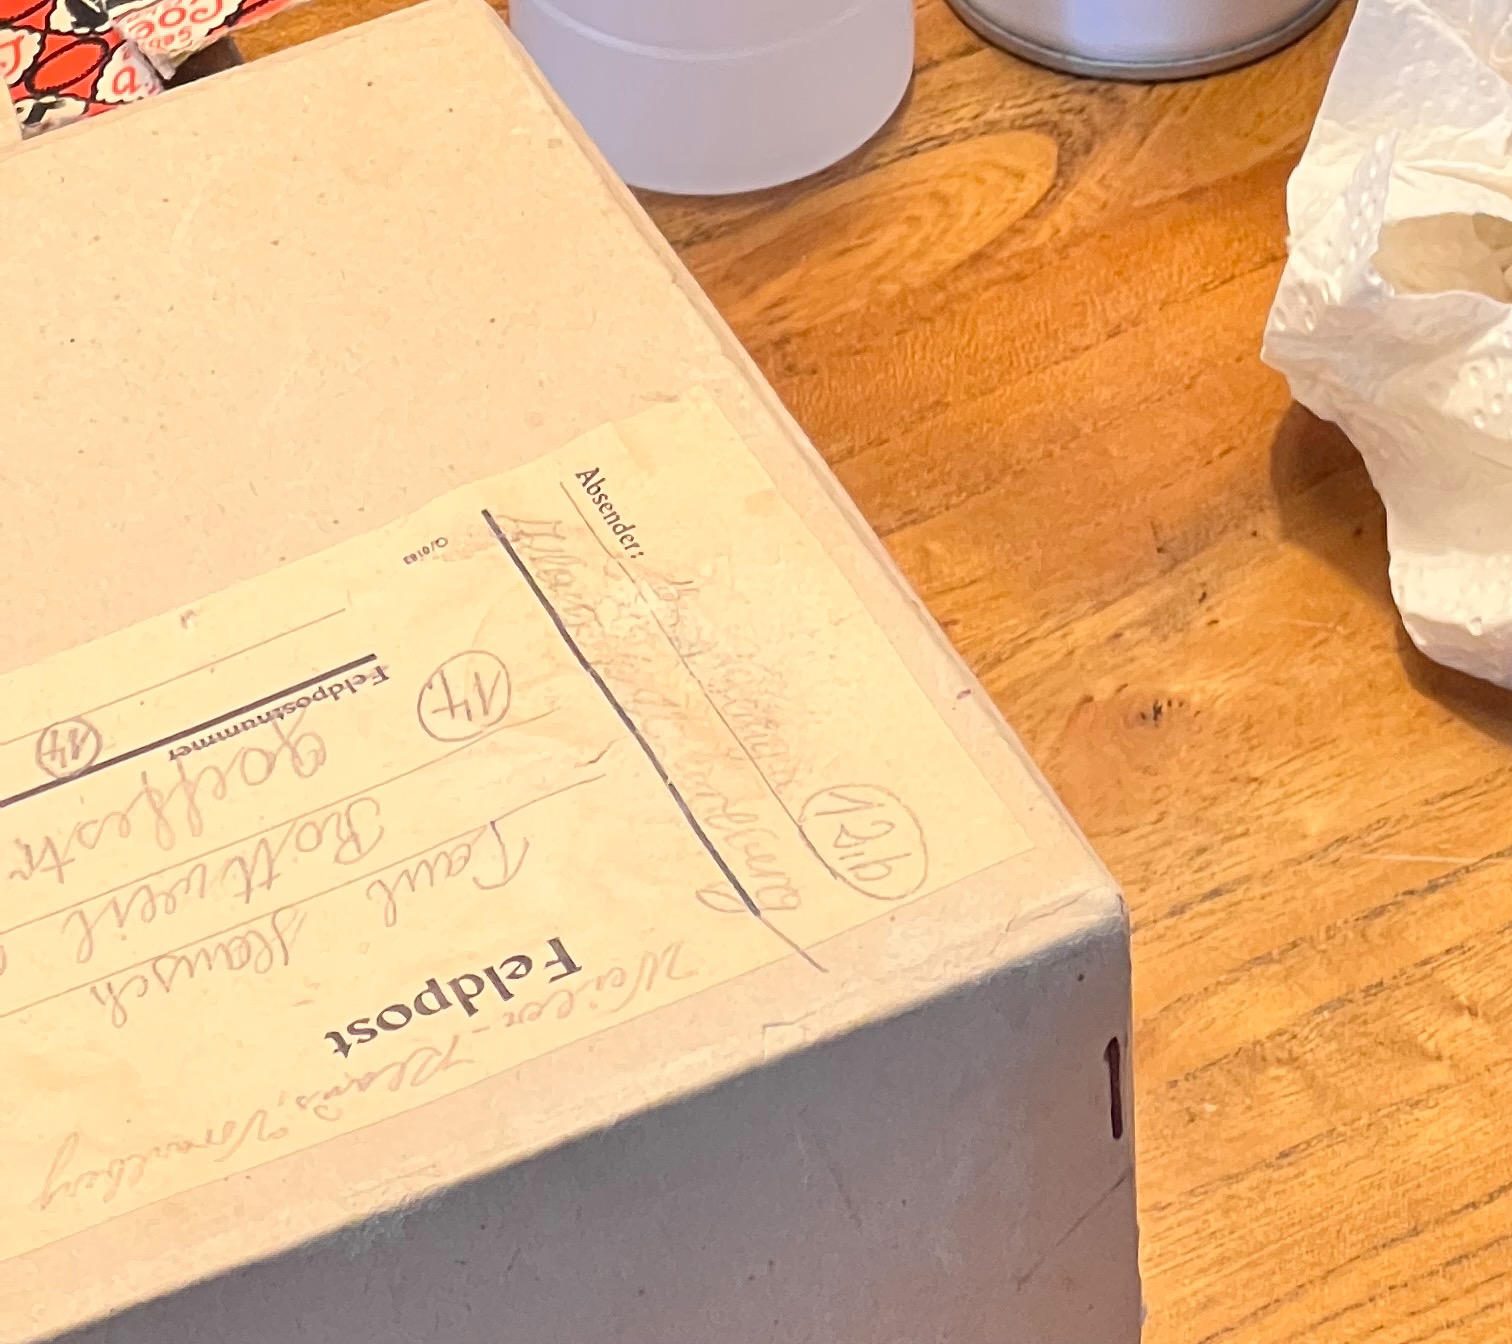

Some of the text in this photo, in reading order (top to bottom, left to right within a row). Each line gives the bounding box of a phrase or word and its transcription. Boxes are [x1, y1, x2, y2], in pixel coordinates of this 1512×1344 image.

[572, 462, 648, 563] Absender:
[168, 660, 393, 766] Feldpostnummer
[323, 935, 585, 1060] Feldpost
